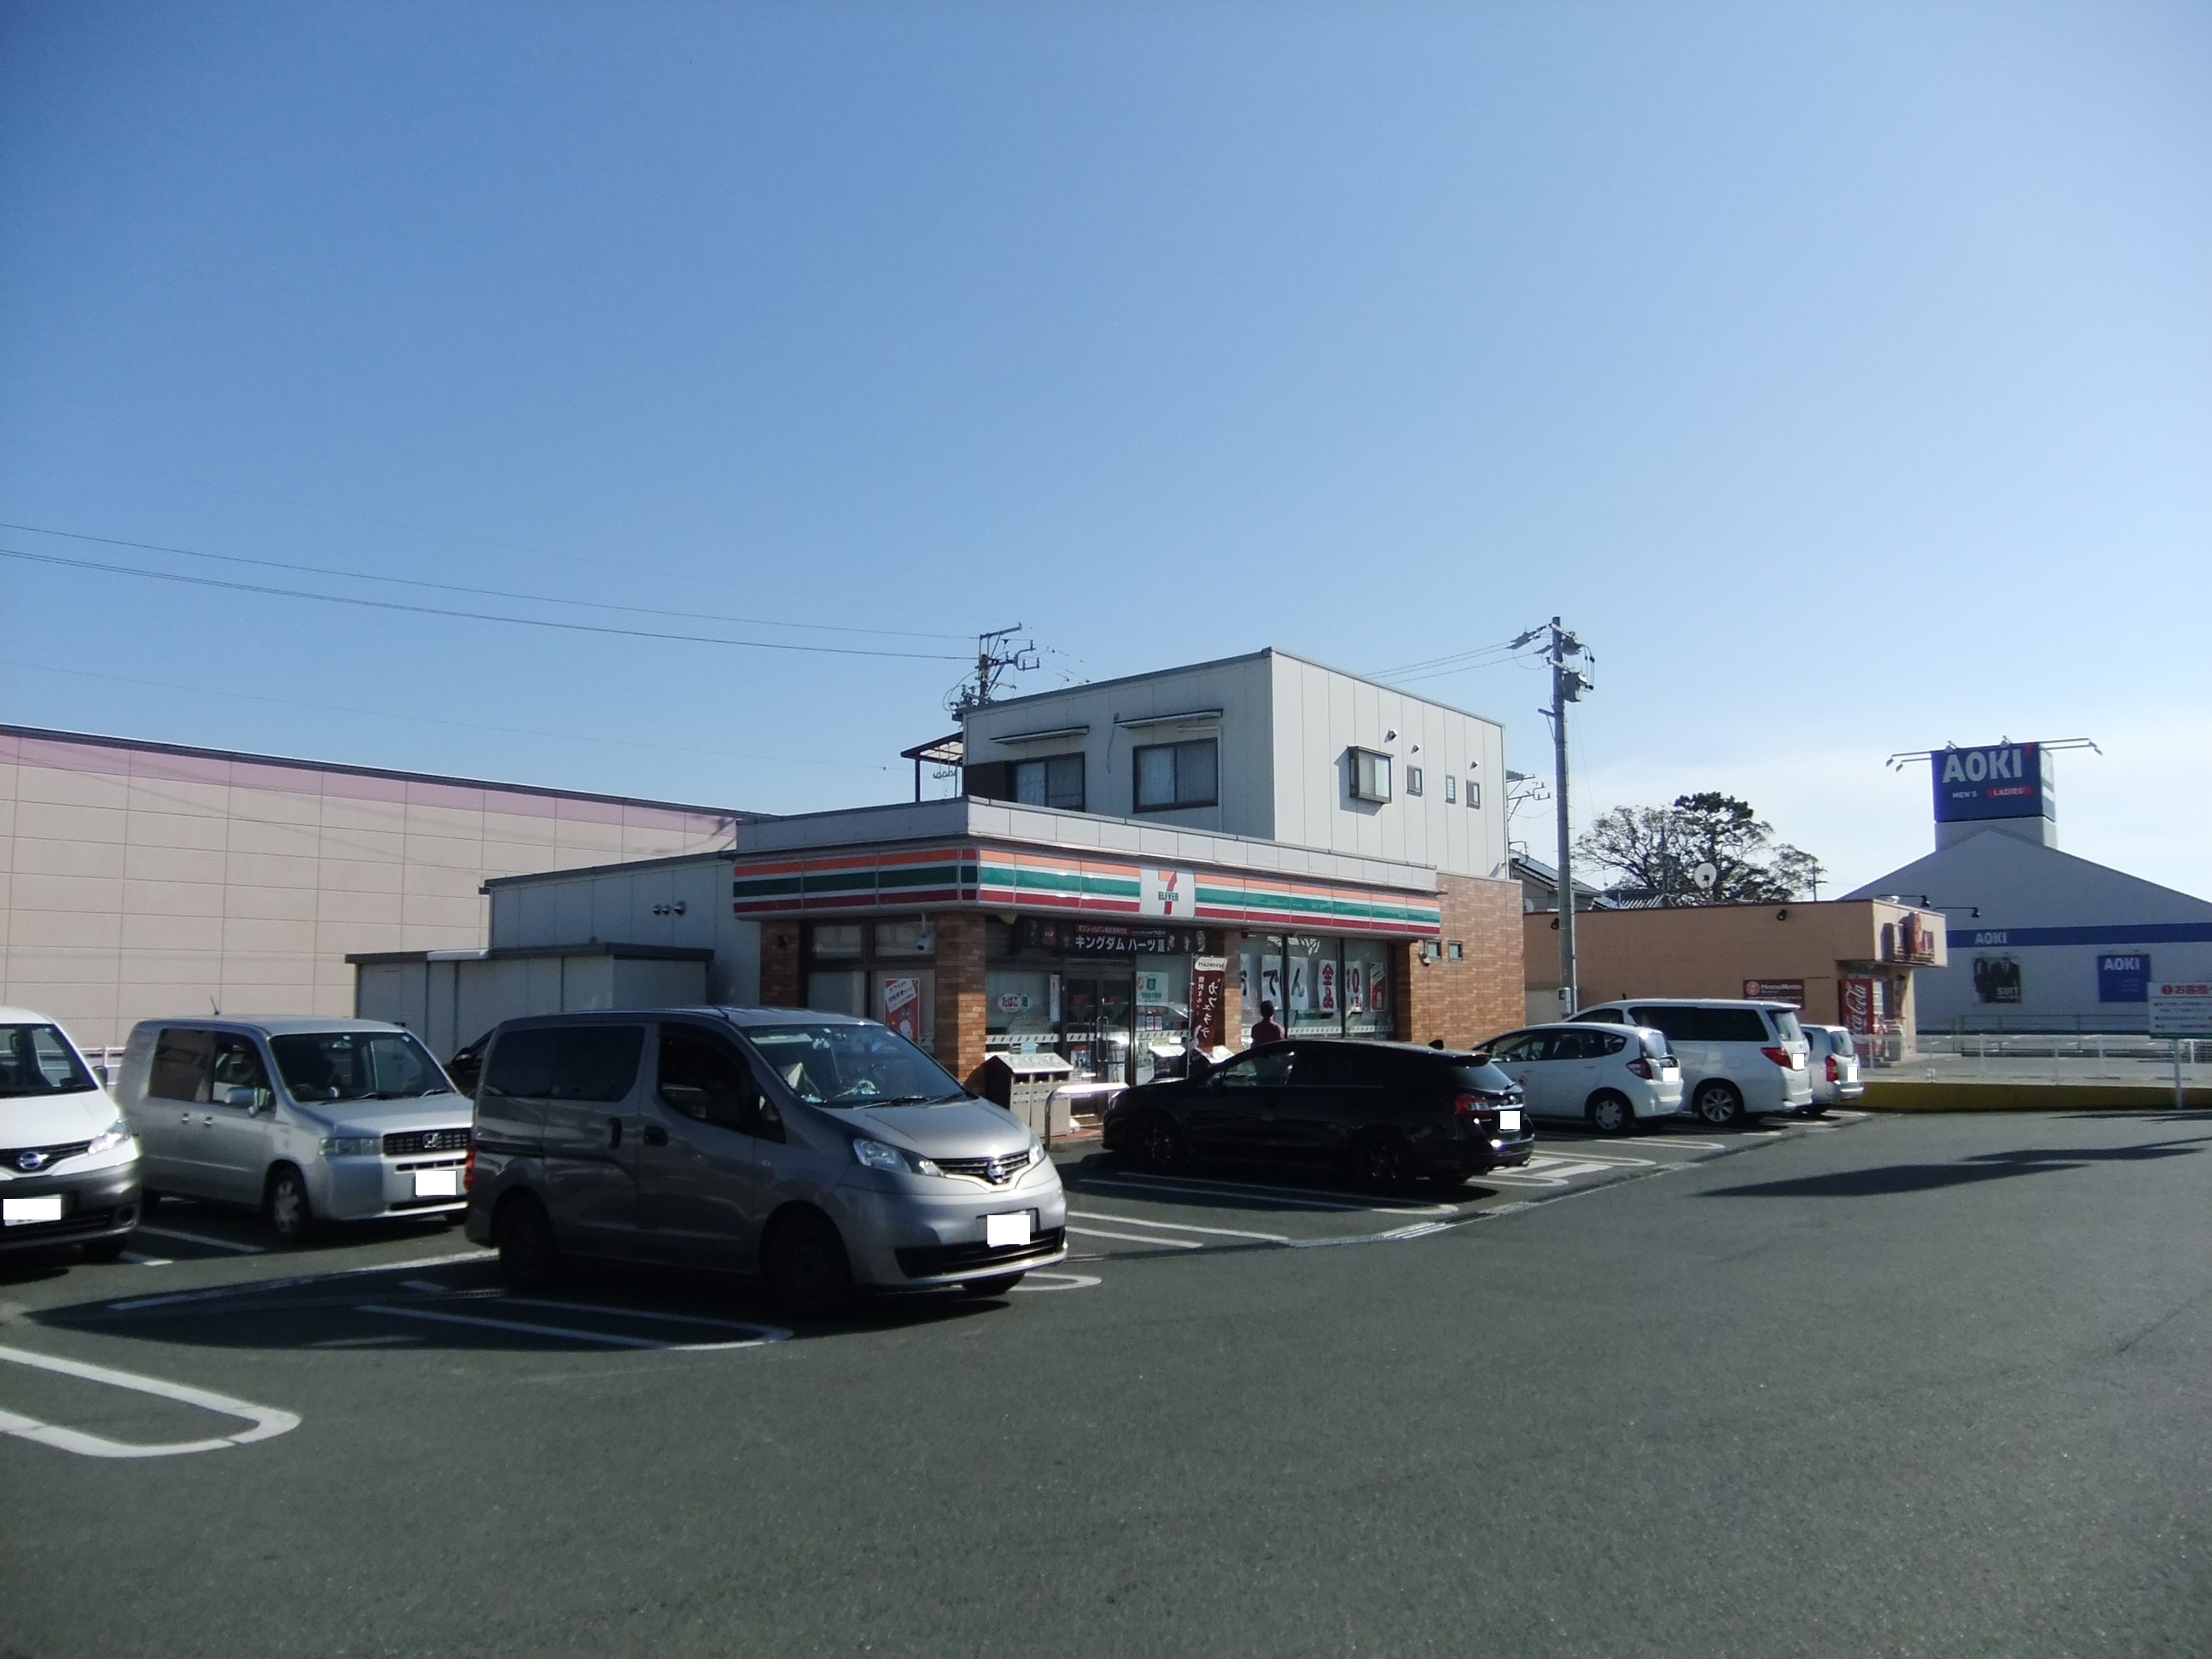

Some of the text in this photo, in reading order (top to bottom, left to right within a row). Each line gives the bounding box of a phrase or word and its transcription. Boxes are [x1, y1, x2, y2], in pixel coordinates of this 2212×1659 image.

[1942, 749, 2023, 783] AOKI
[1952, 790, 1977, 799] MEN'S
[1158, 870, 1178, 915] 7
[1075, 934, 1125, 952] キングダム
[1975, 932, 2007, 945] AOKI
[2104, 957, 2139, 971] AOKI
